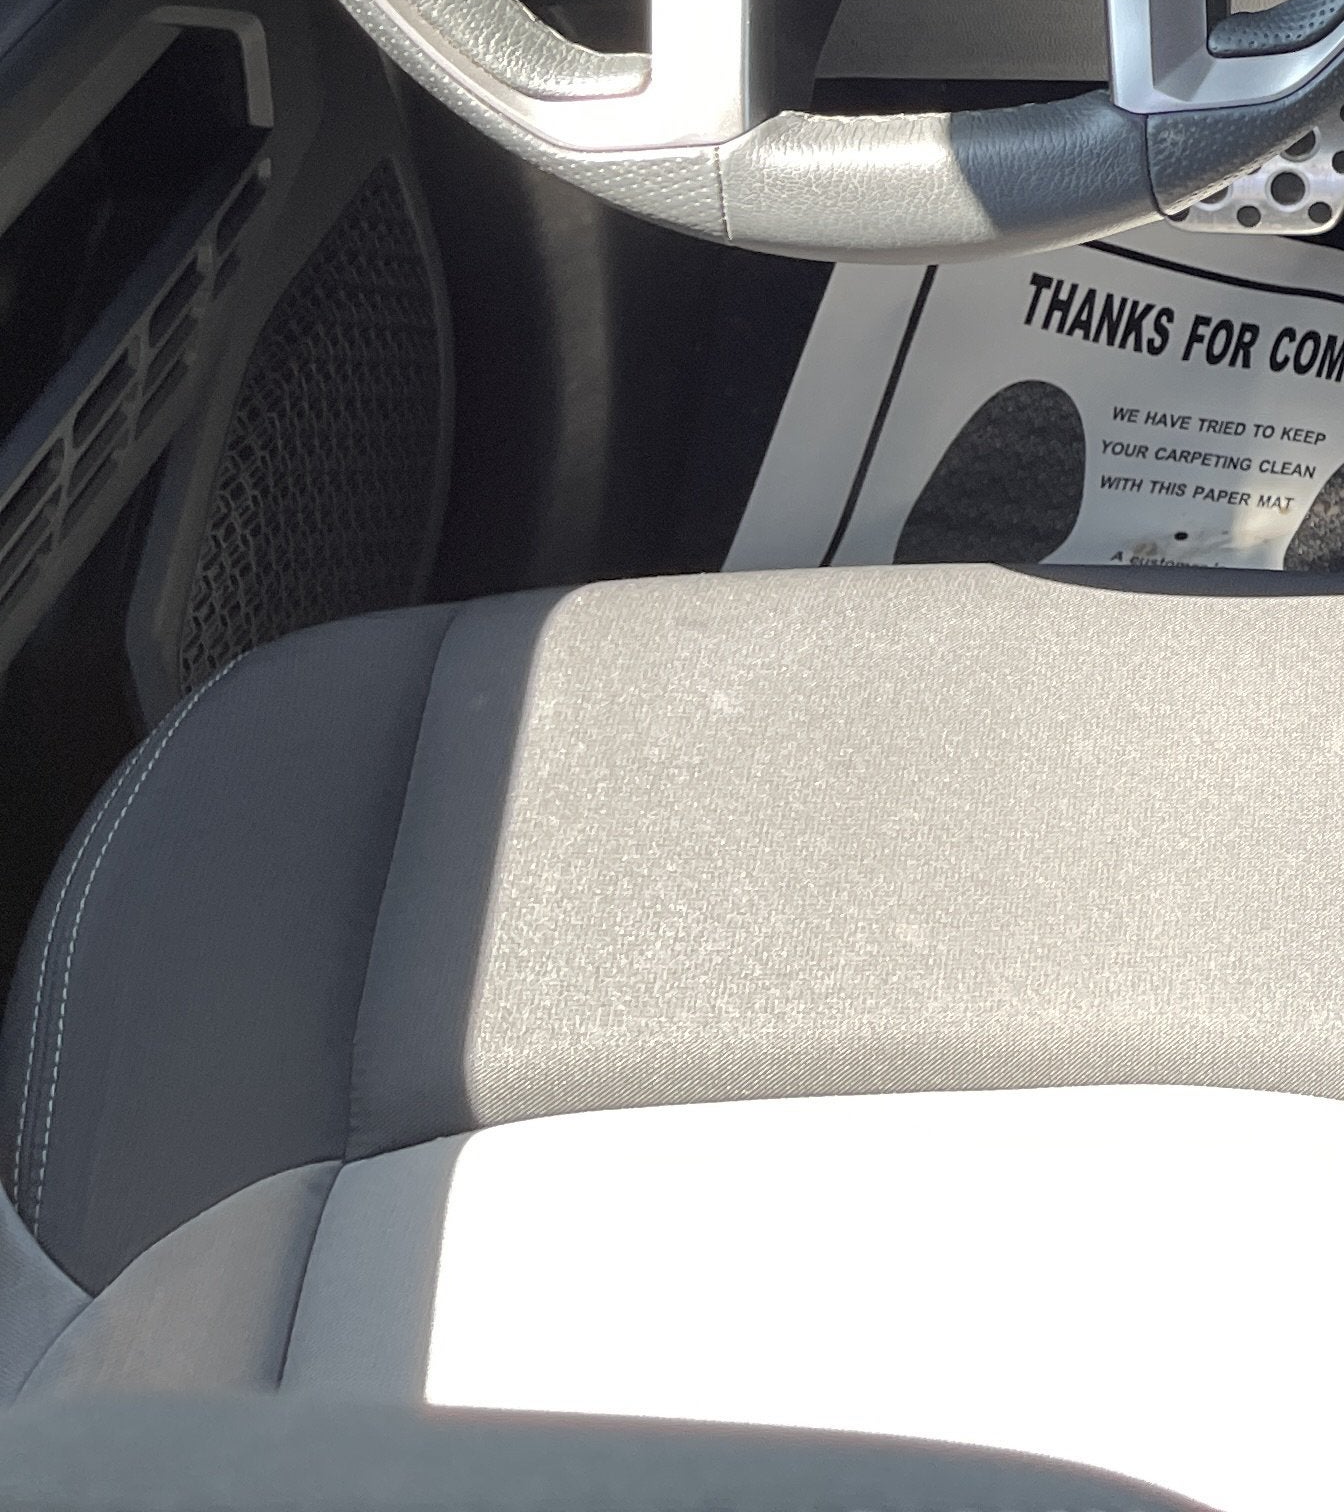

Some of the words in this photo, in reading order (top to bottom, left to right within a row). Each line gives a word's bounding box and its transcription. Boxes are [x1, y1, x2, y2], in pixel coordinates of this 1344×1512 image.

[1023, 272, 1175, 357] THANKS
[1181, 313, 1260, 369] FOR
[1112, 405, 1140, 423] WE
[1144, 410, 1192, 430] HAVE
[1199, 417, 1247, 437] TRIED
[1253, 423, 1275, 439] TO
[1280, 426, 1327, 446] KEEP
[1101, 439, 1149, 460] YOUR
[1154, 446, 1253, 472] CARPETING
[1258, 459, 1317, 479] CLEAN
[1101, 474, 1144, 493] WITH
[1150, 479, 1188, 497] THIS
[1192, 485, 1251, 507] PAPER
[1257, 495, 1295, 512] MAT
[1110, 550, 1124, 562] A
